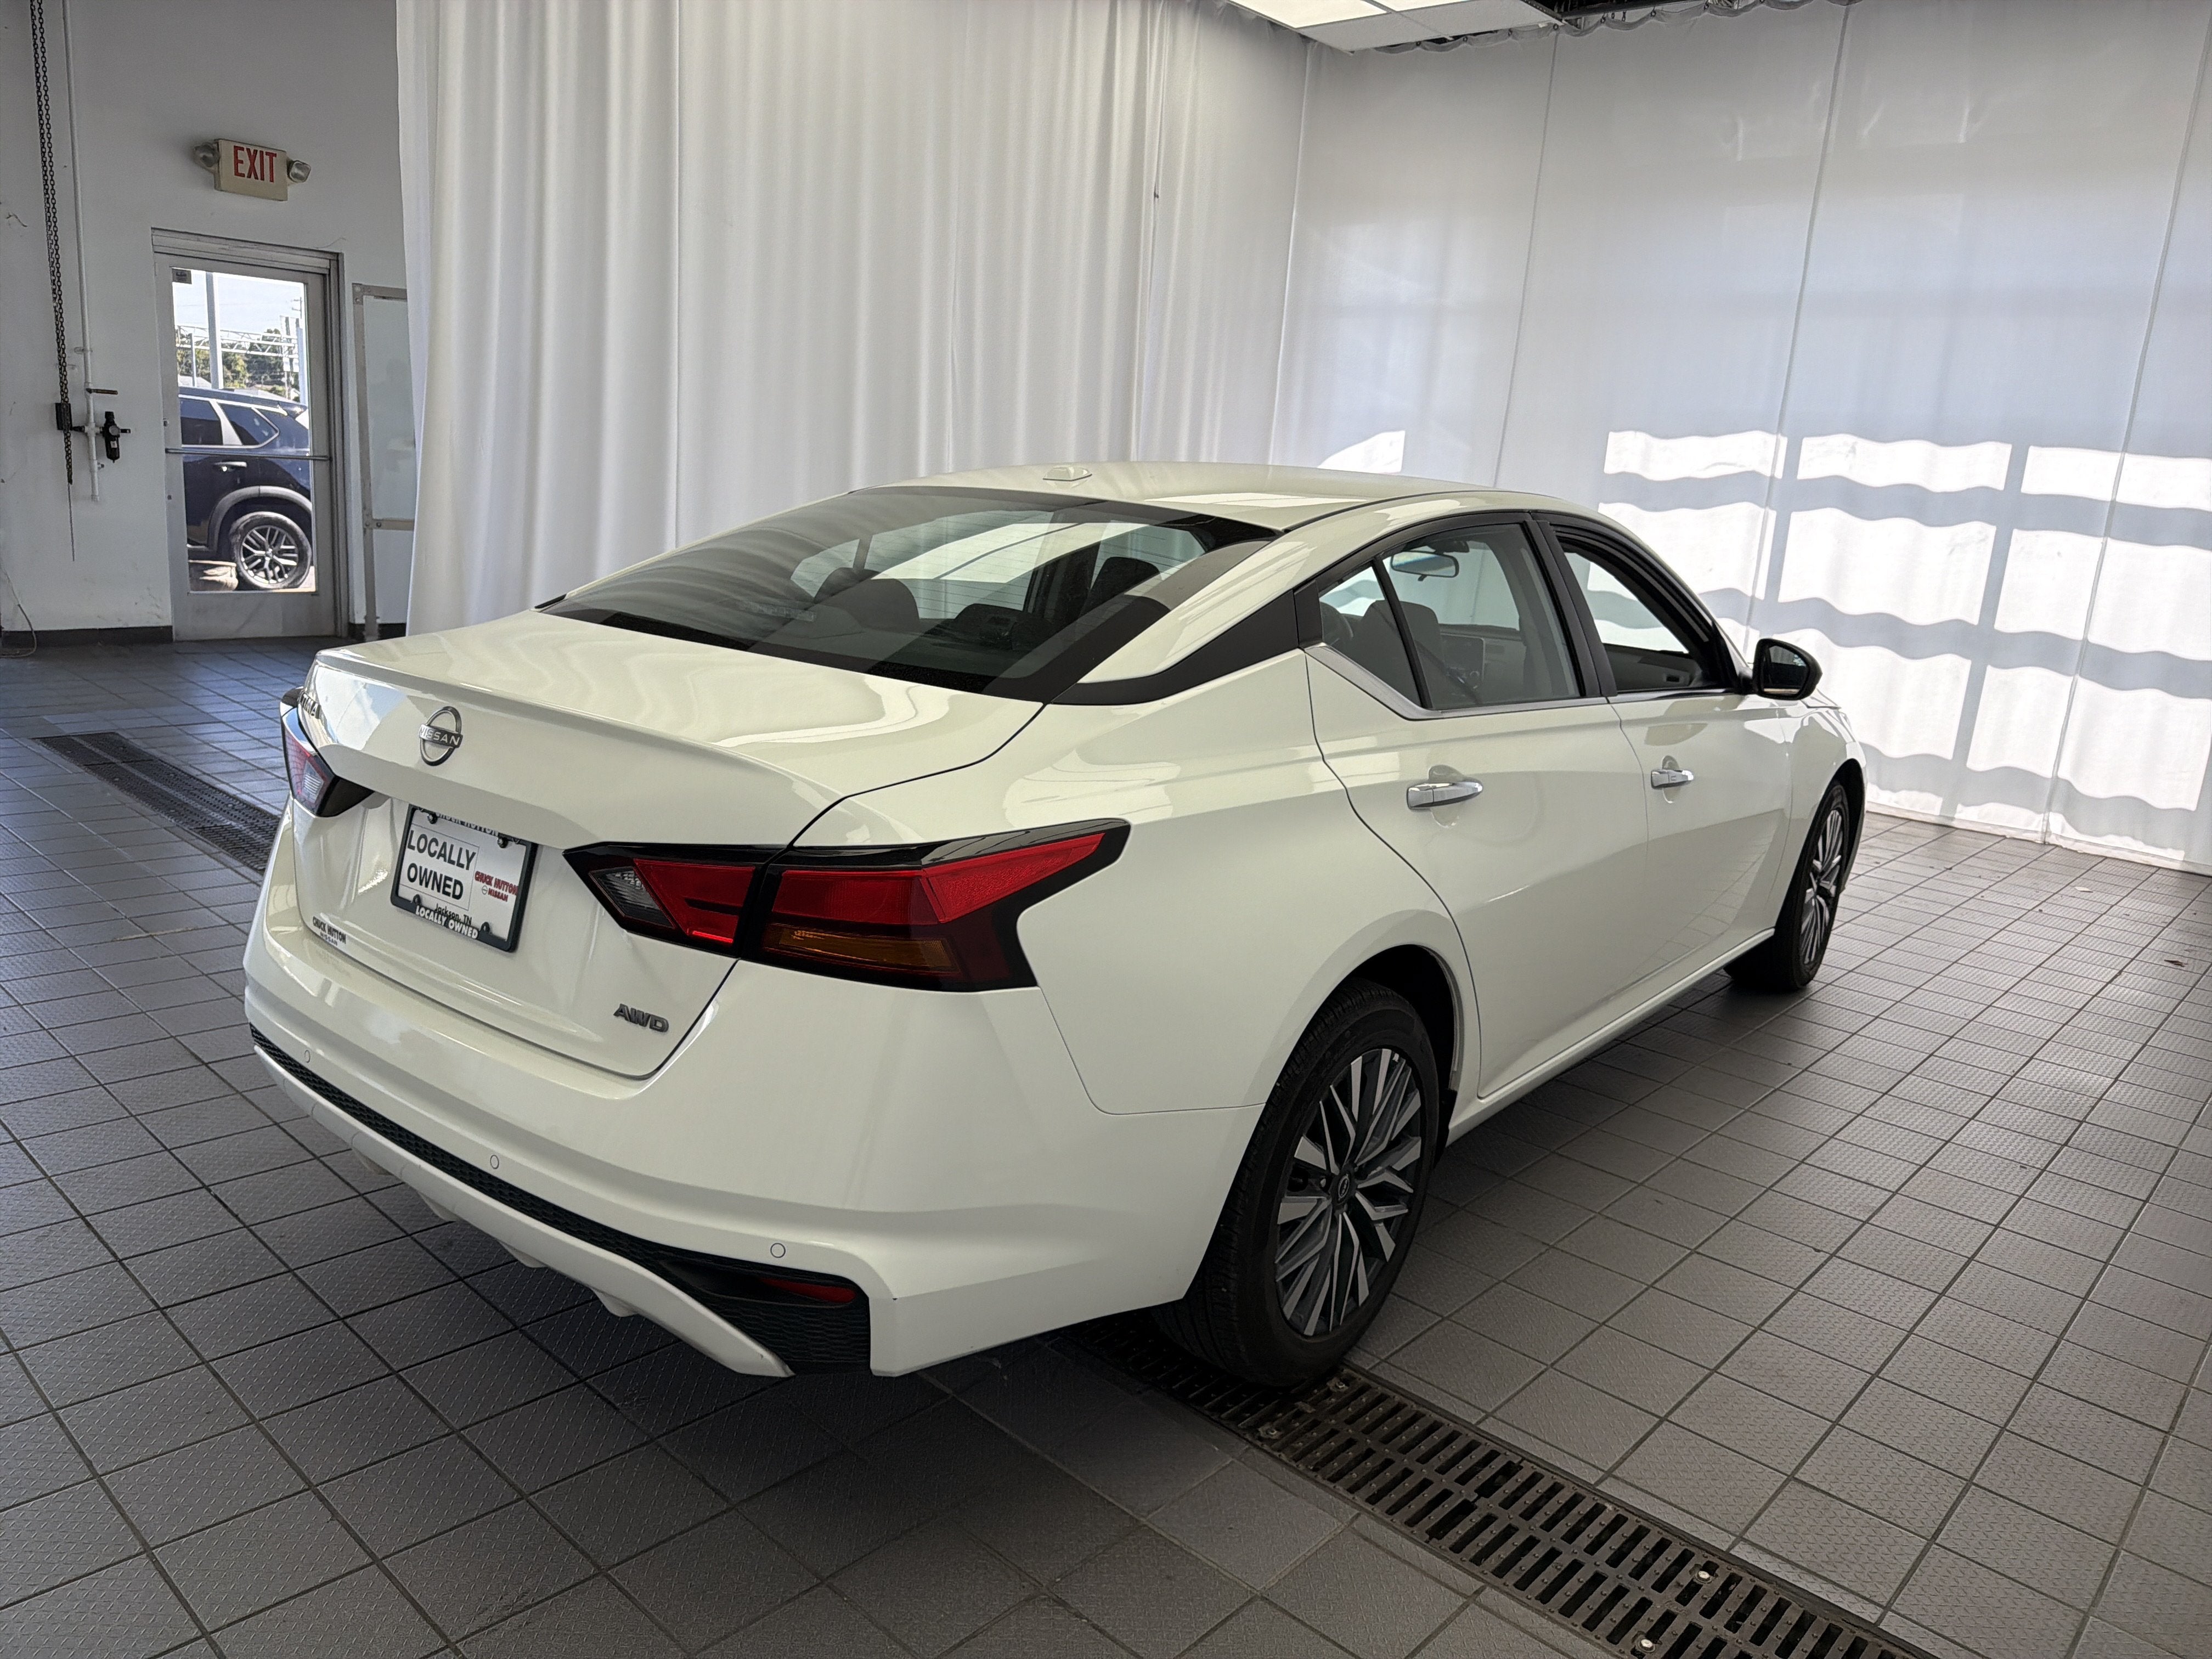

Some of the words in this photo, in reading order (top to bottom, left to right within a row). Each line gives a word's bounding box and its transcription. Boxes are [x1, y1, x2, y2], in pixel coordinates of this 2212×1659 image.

[233, 145, 277, 183] EXIT
[408, 830, 476, 871] LOCALLY
[407, 863, 464, 900] OWNED
[475, 871, 494, 887] CHUCK
[494, 878, 518, 896] HUTTON
[488, 888, 509, 902] NISSAN
[416, 905, 447, 926] LOCALLY
[449, 919, 478, 939] OWNED
[464, 915, 472, 926] TN
[613, 1003, 669, 1032] AWD
